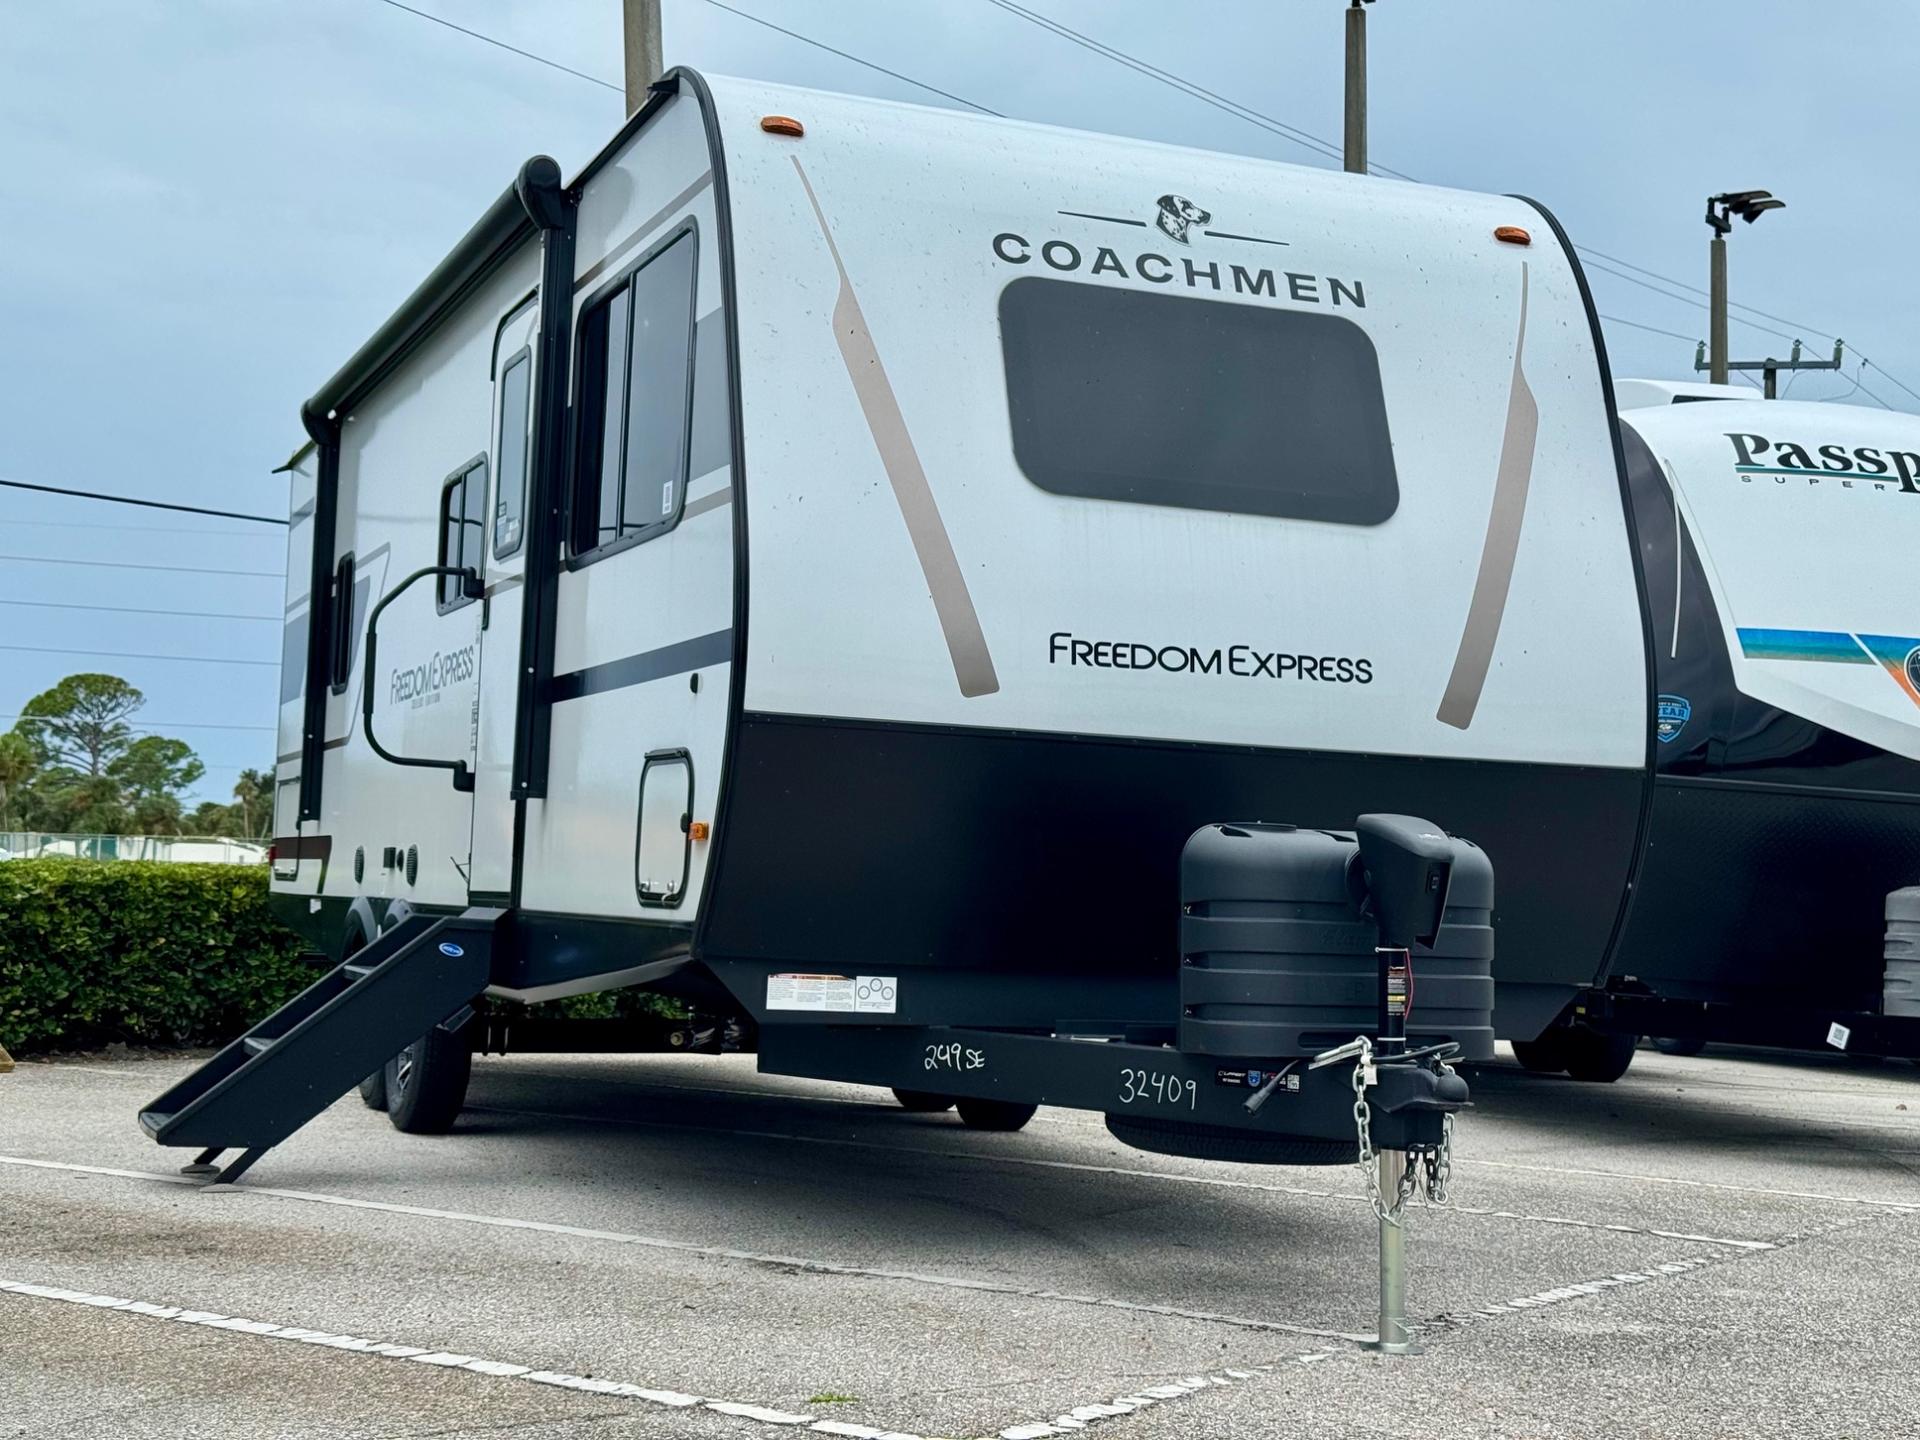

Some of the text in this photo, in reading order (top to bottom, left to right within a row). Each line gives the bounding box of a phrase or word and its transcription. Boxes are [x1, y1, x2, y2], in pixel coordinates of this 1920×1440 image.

[992, 232, 1367, 309] COACHMEN
[1740, 475, 1886, 491] SUPER
[1119, 1068, 1197, 1110] 32409
